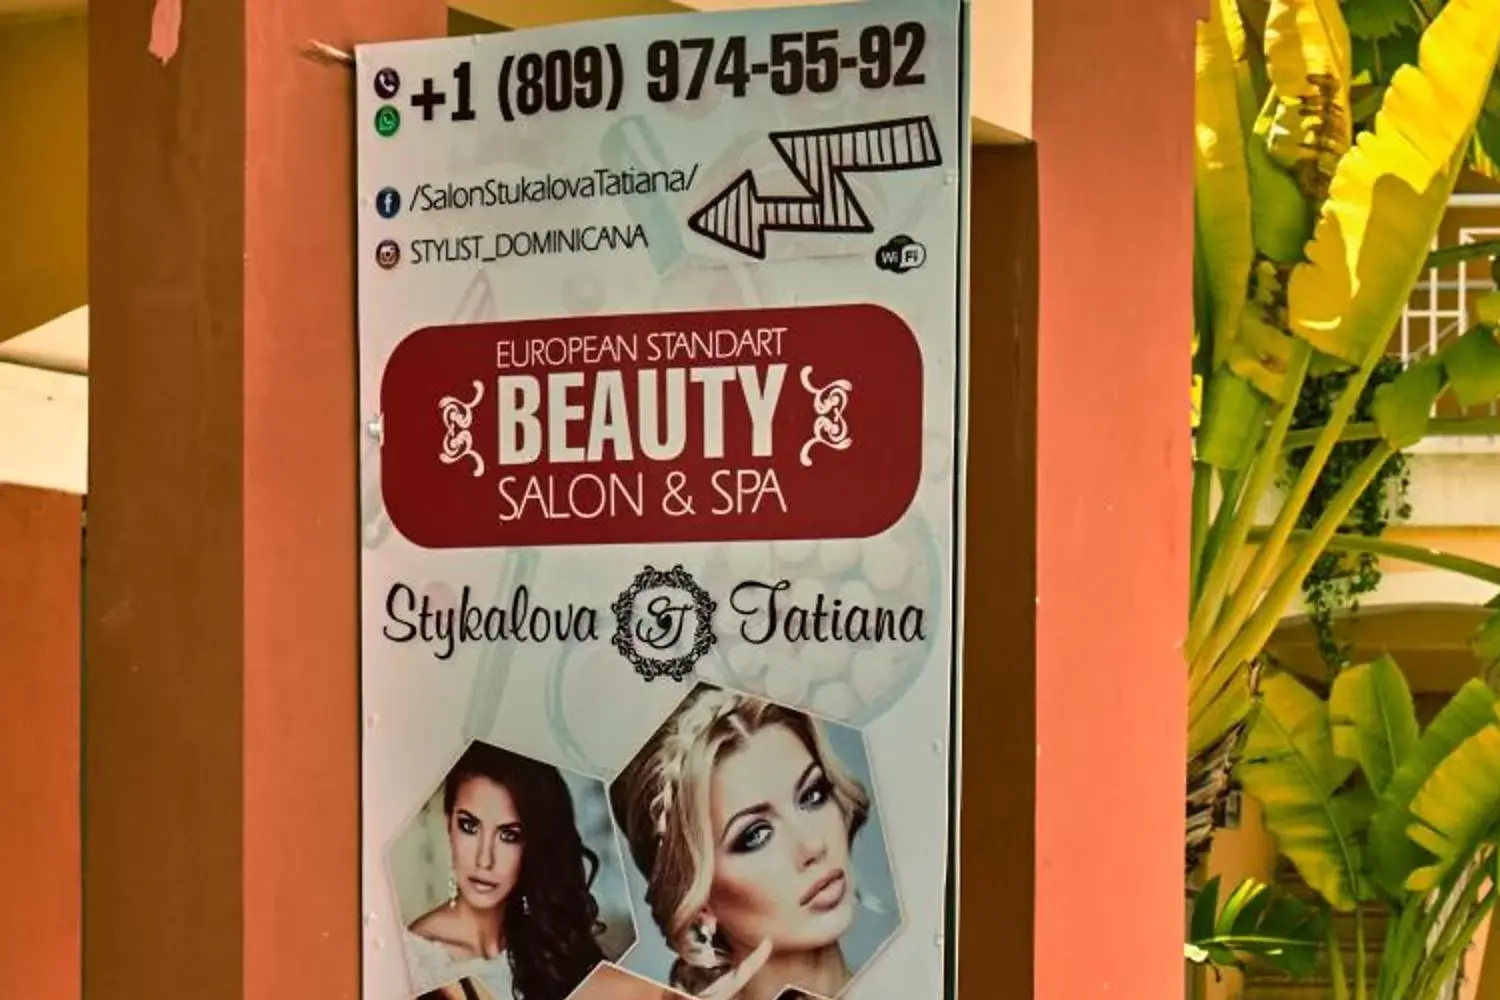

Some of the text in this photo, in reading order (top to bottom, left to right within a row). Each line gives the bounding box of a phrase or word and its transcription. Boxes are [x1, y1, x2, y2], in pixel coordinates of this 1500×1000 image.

[410, 21, 926, 122] +1 (809) 974-55-92
[410, 223, 649, 265] STYLIST_DOMINICANA
[496, 327, 787, 368] EUROPEAN STANDART
[498, 363, 788, 465] BEAUTY
[498, 469, 787, 522] SALON & SPA
[382, 582, 599, 661] Stykalova
[730, 578, 926, 645] Tatiana
